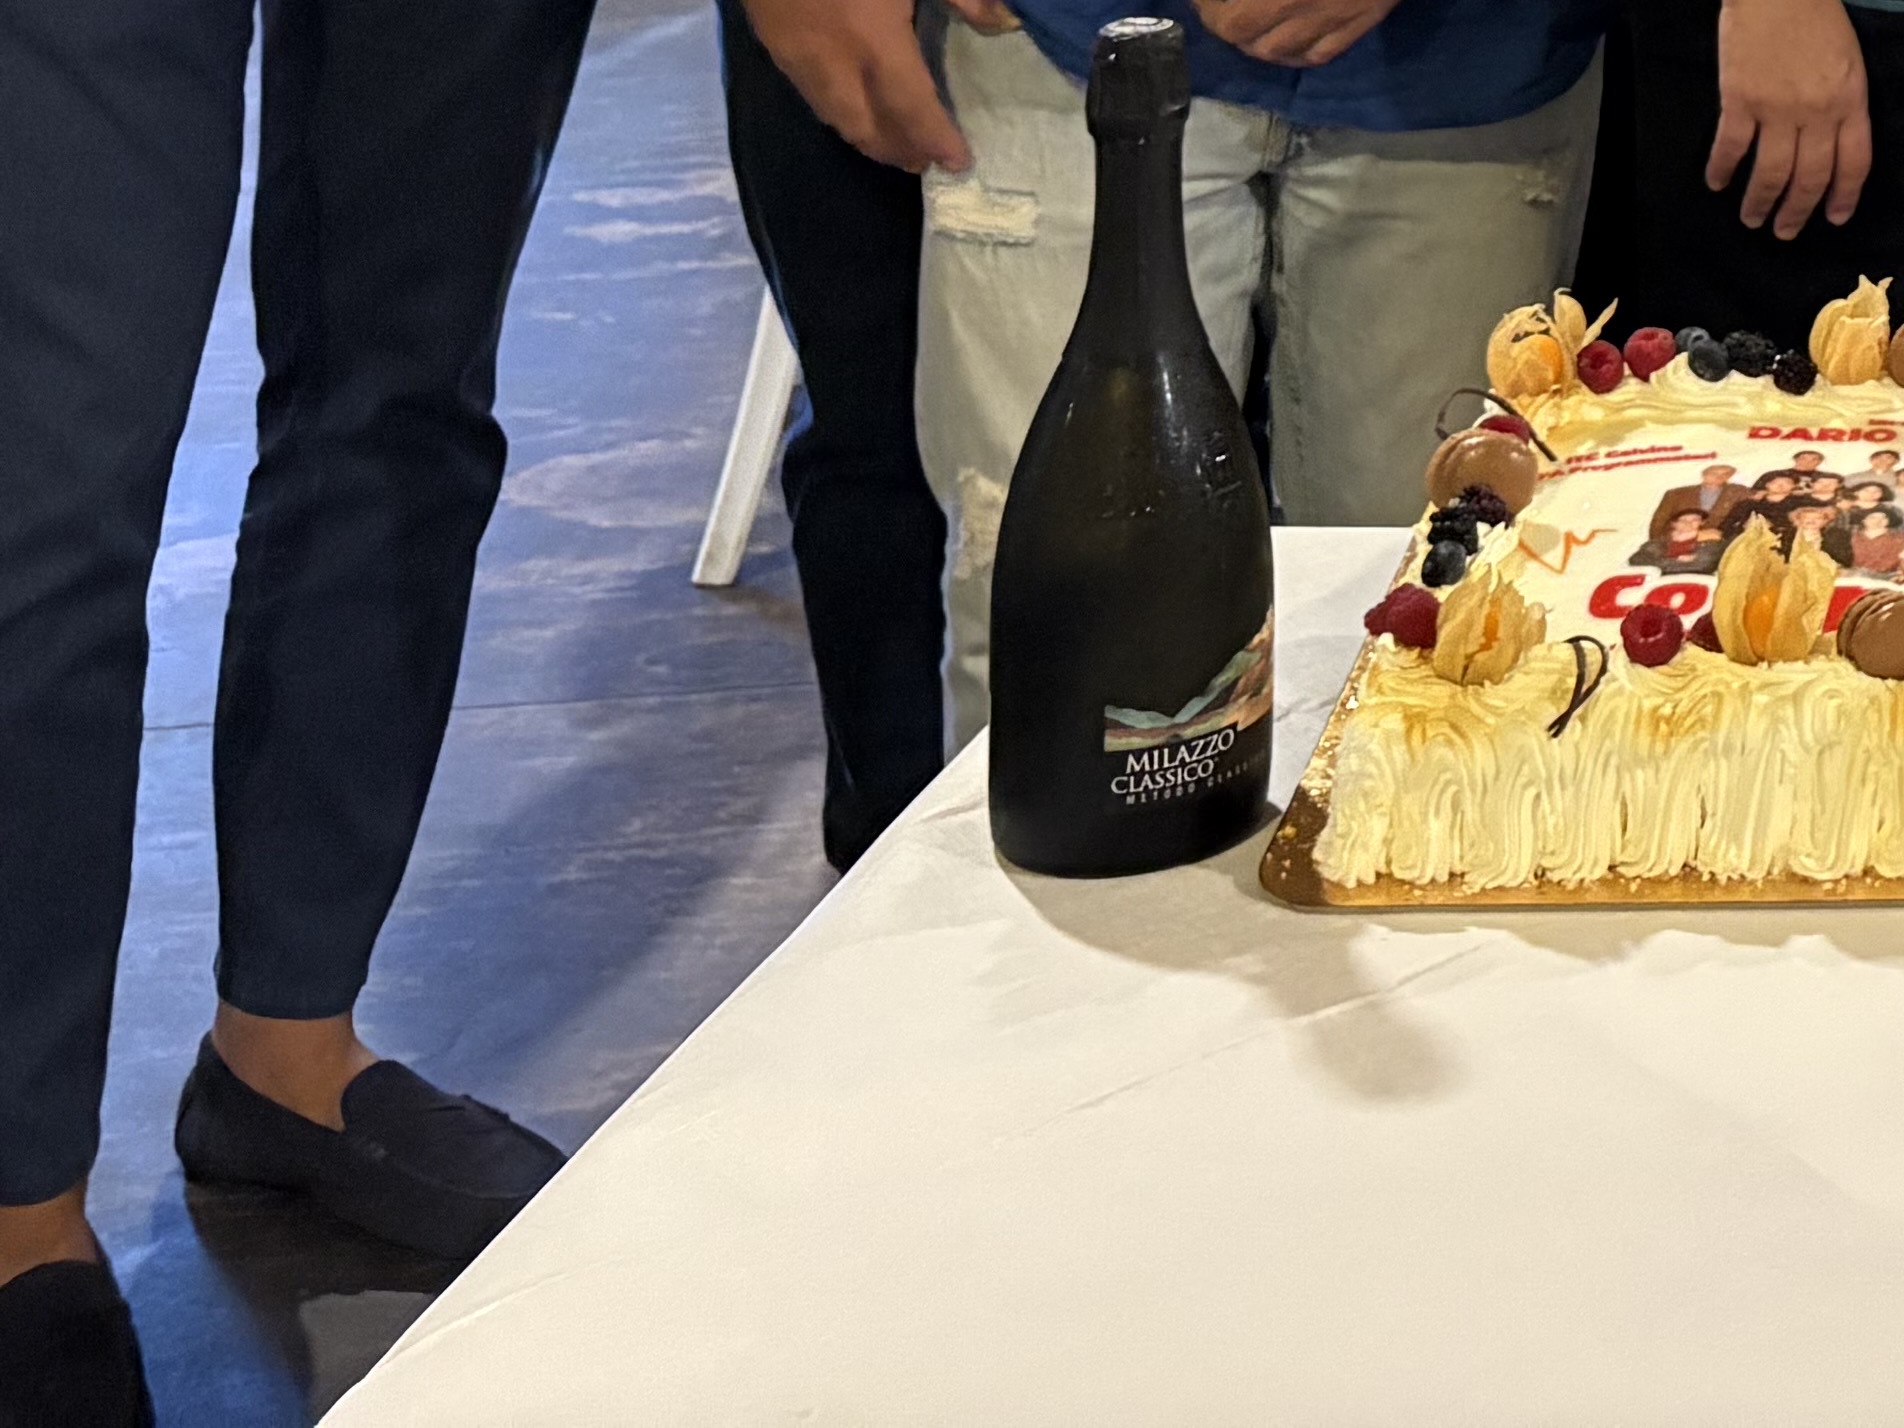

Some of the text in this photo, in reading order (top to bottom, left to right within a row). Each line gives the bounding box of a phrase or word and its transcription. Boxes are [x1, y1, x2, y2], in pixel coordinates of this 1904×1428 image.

[1748, 425, 1899, 443] DARIO
[1125, 728, 1235, 775] MILAZZO
[1110, 758, 1215, 794] CLASSICO
